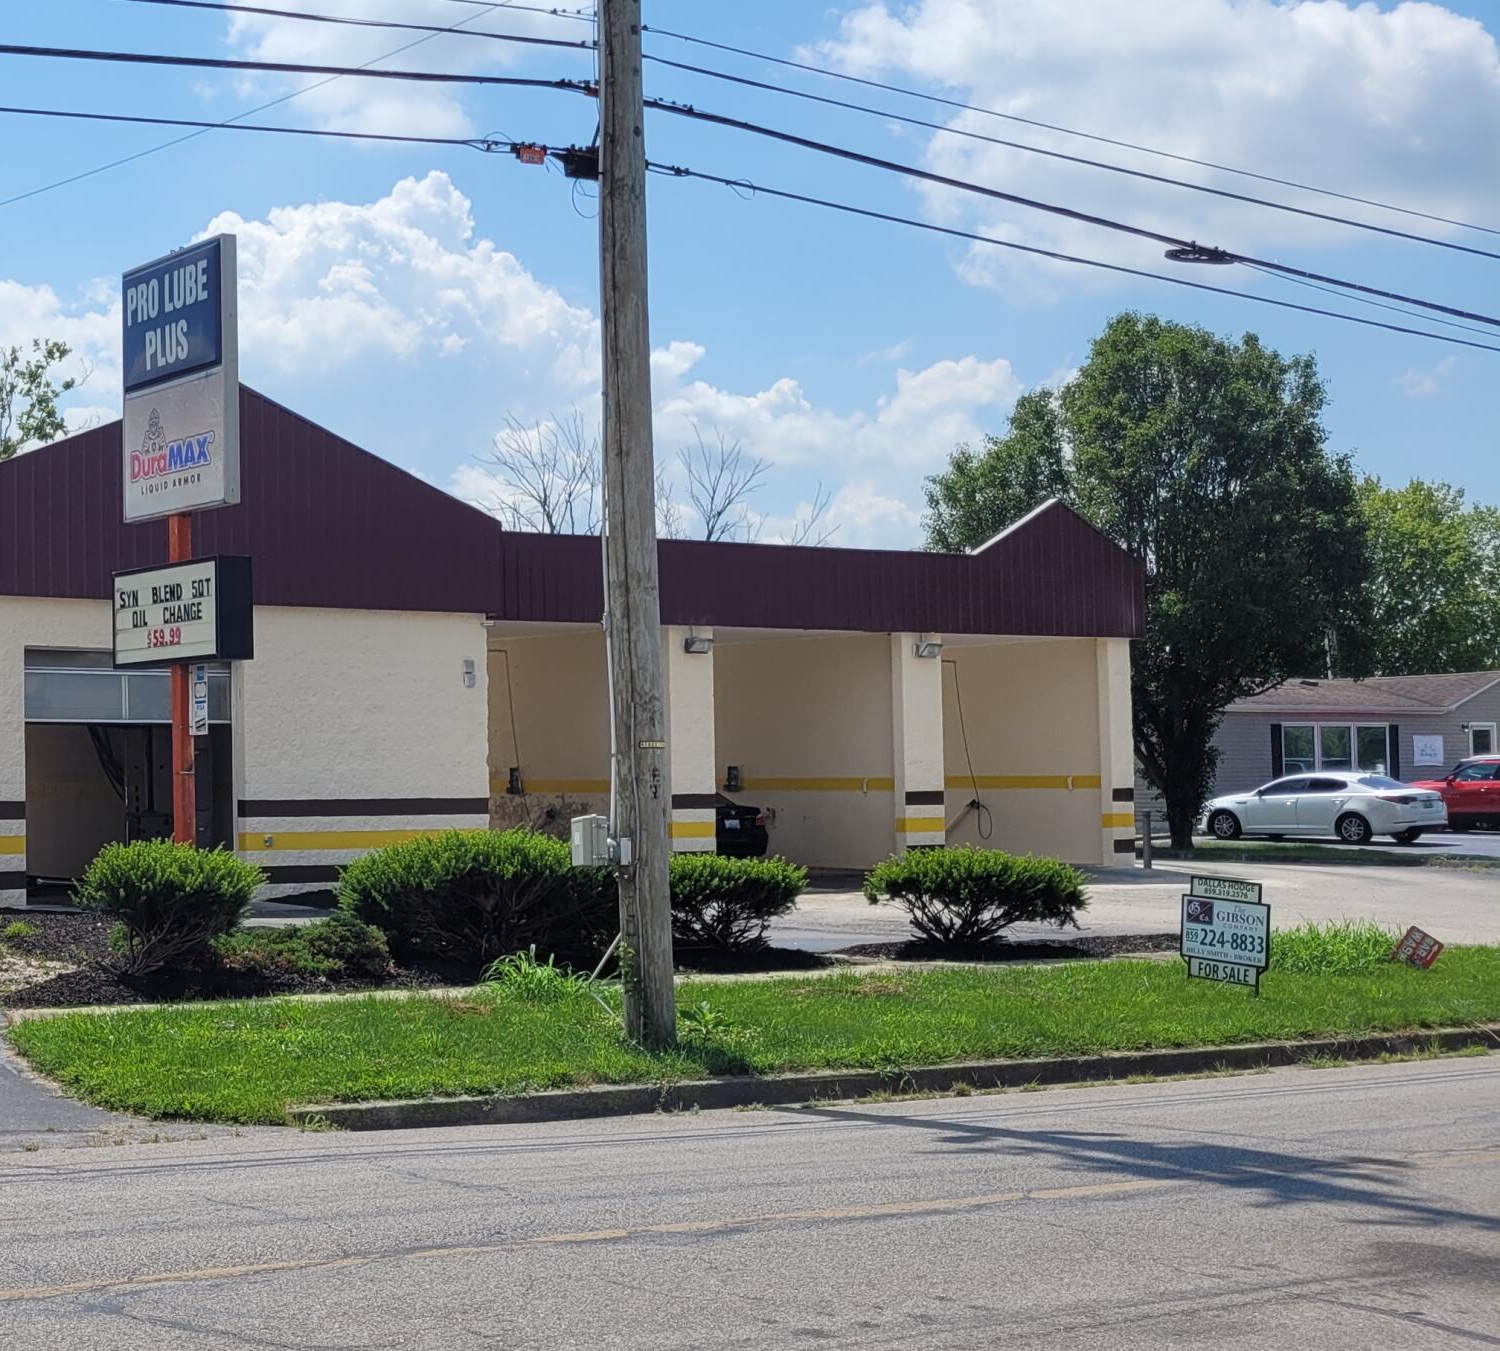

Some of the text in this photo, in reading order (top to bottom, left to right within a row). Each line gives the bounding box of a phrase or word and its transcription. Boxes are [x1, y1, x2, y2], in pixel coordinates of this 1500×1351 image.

[127, 258, 208, 327] PRO LUBE
[145, 319, 189, 371] PLUS
[131, 436, 210, 483] DuraMAX
[141, 473, 201, 496] LIQUID ARMOR
[119, 589, 139, 610] SYN
[152, 584, 182, 604] BLEND
[132, 602, 202, 629] OIL CHANGE
[147, 626, 182, 648] $59.99
[1198, 878, 1256, 893] DALLAS HODGE
[1204, 888, 1248, 900] 859.319.2576
[1216, 911, 1264, 928] GIBSON
[1233, 905, 1247, 914] The
[1223, 923, 1258, 932] COMPANY
[1186, 928, 1264, 954] 859 224-8833
[1187, 947, 1205, 955] BILLY
[1206, 950, 1228, 959] SMITH
[1234, 954, 1262, 963] BROKER
[1198, 962, 1250, 984] FOR SALE
